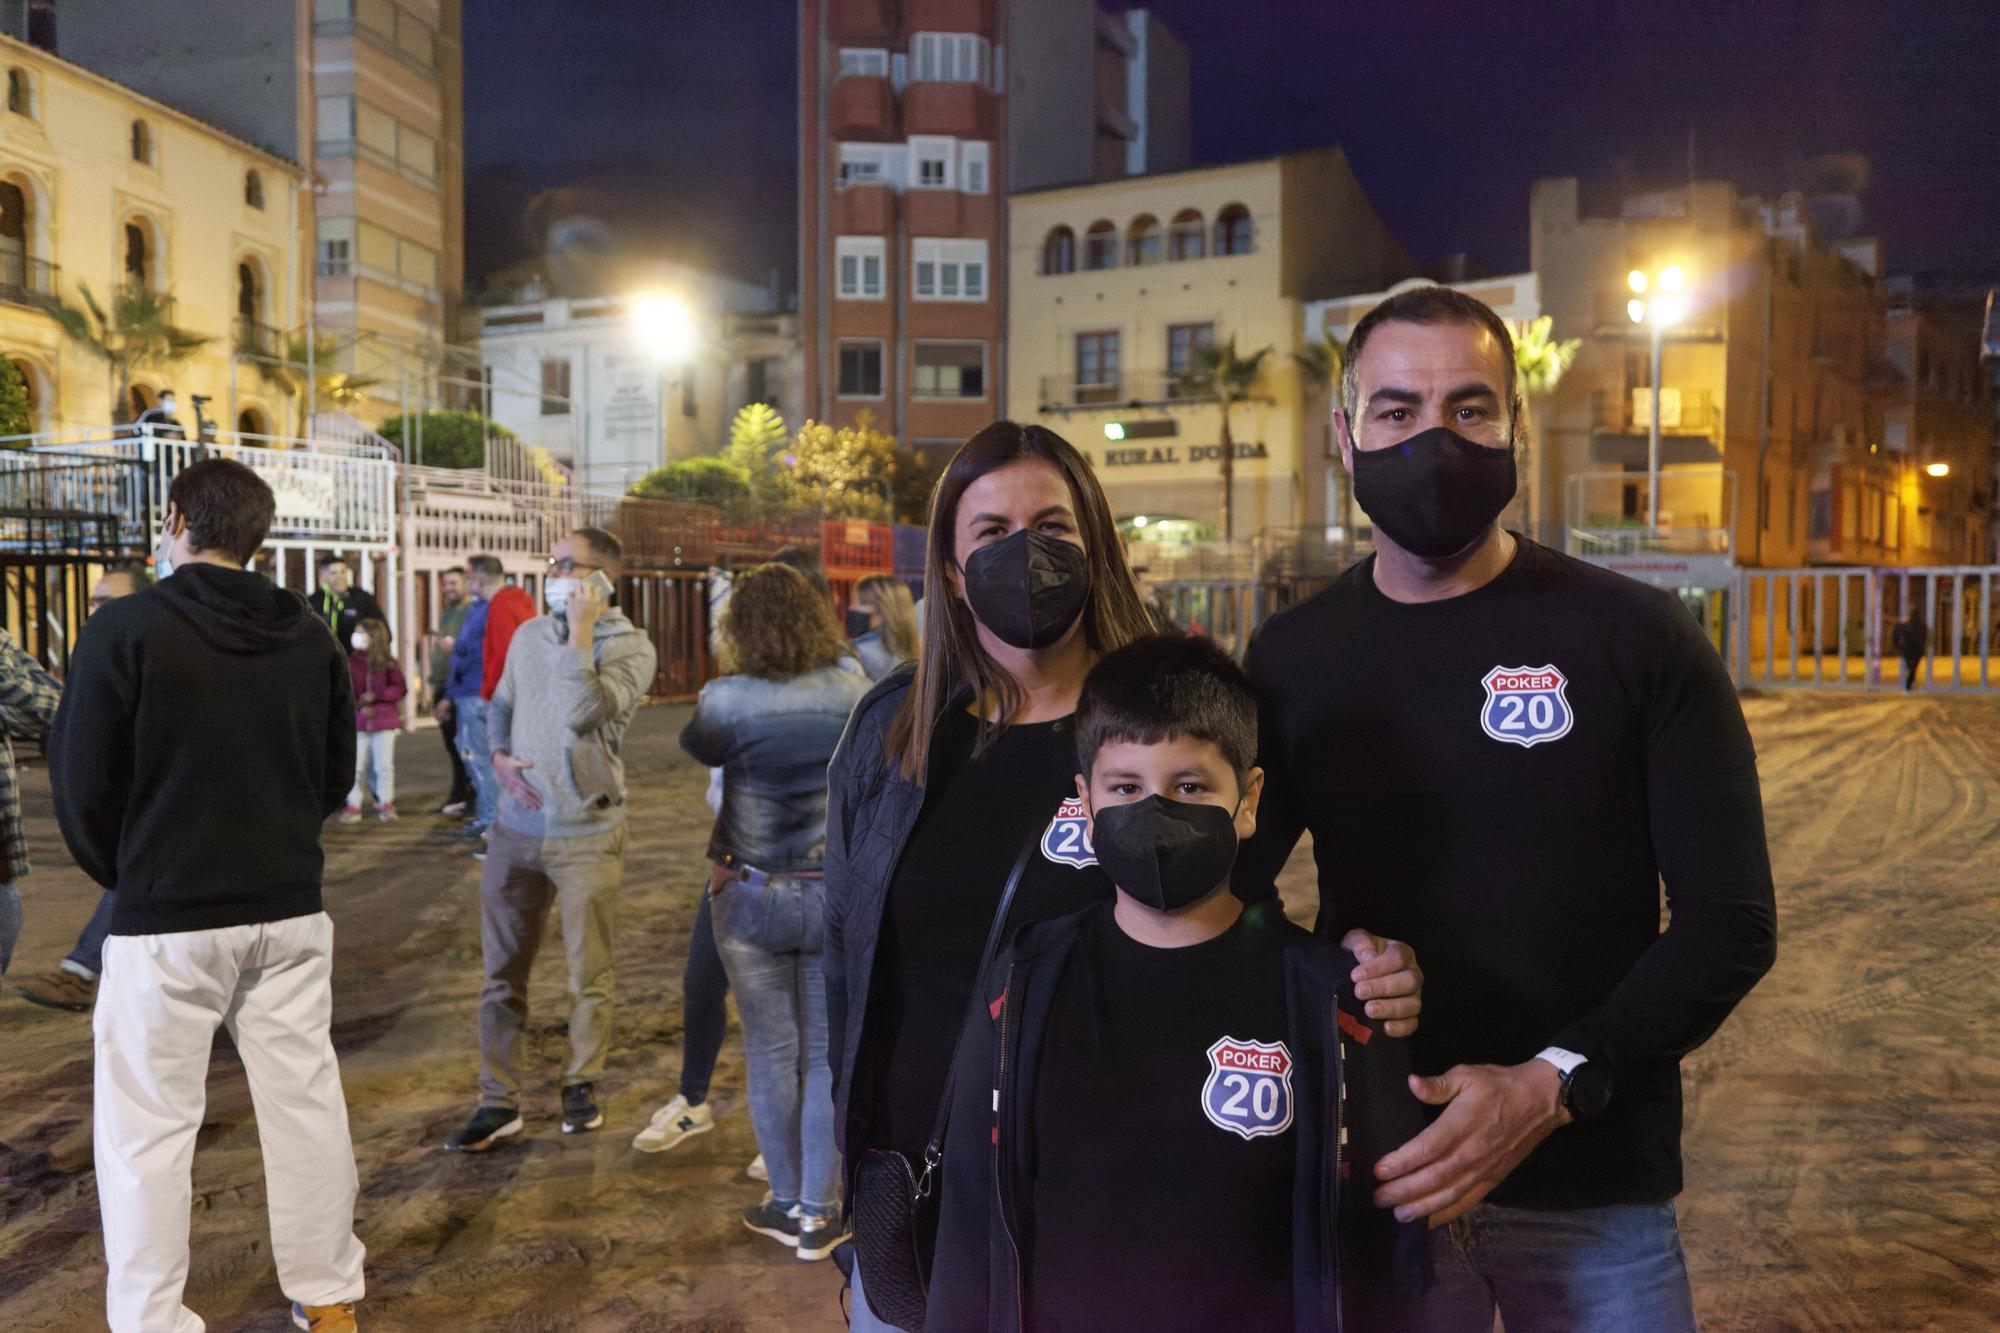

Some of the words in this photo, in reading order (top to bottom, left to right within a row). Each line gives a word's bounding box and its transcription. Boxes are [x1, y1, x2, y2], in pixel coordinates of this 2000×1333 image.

[1496, 676, 1553, 690] POKER
[1499, 694, 1554, 730] 20
[1222, 1049, 1281, 1071] POKER
[1220, 1073, 1279, 1121] 20
